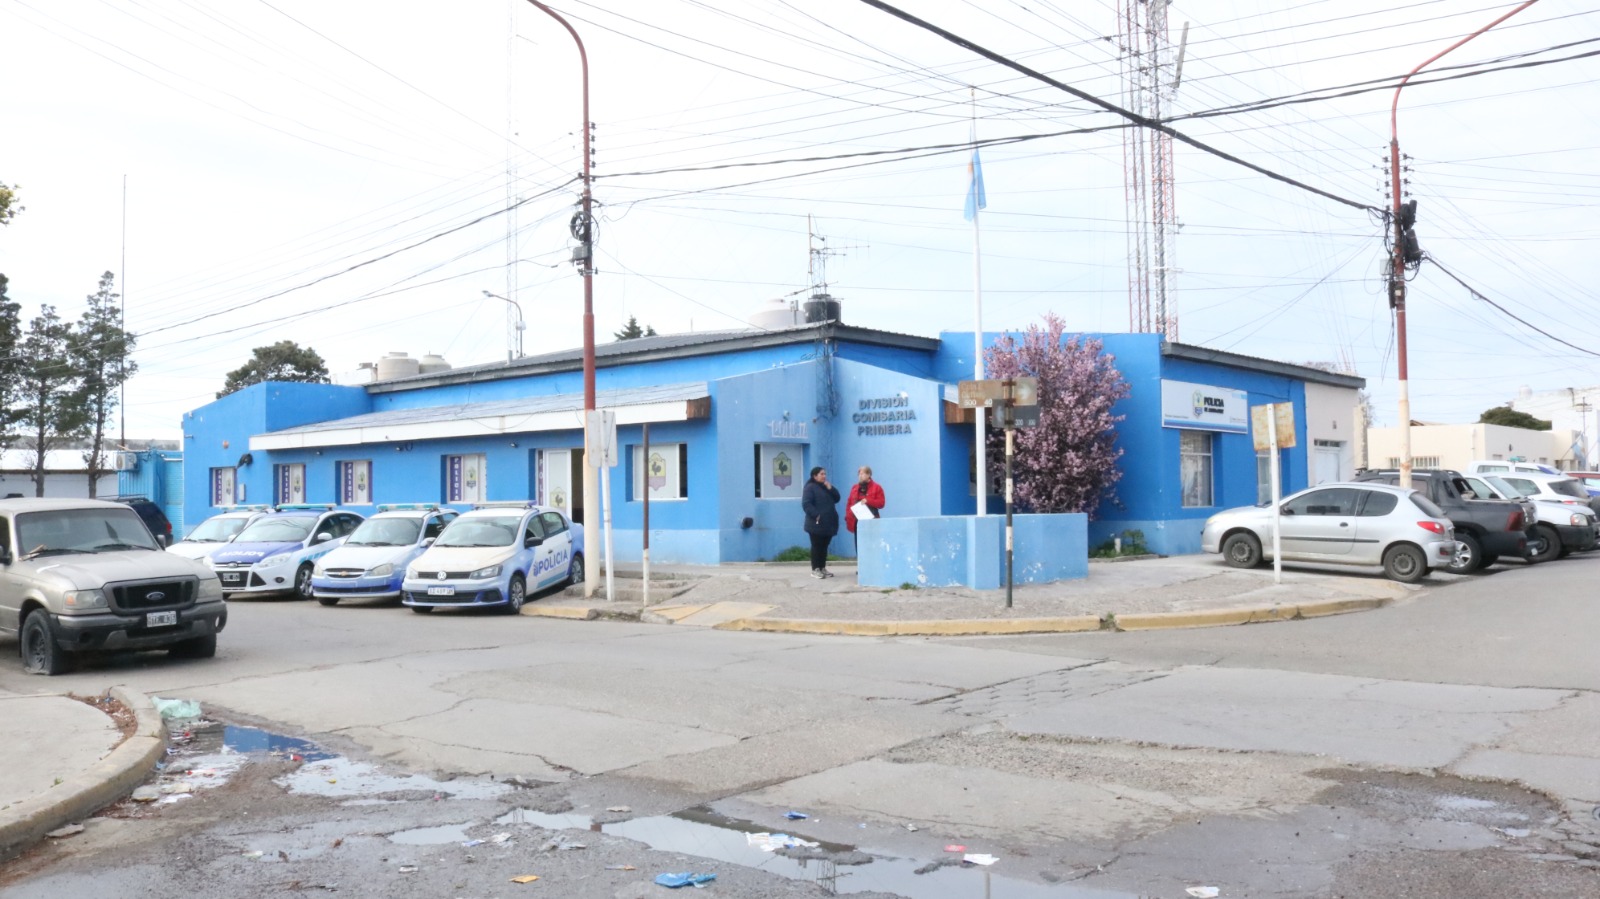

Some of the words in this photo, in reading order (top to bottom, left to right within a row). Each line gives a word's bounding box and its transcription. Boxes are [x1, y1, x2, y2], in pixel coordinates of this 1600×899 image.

[852, 409, 916, 423] COMISARIA
[857, 424, 912, 437] PRIMERA
[538, 549, 568, 574] POLICIA
